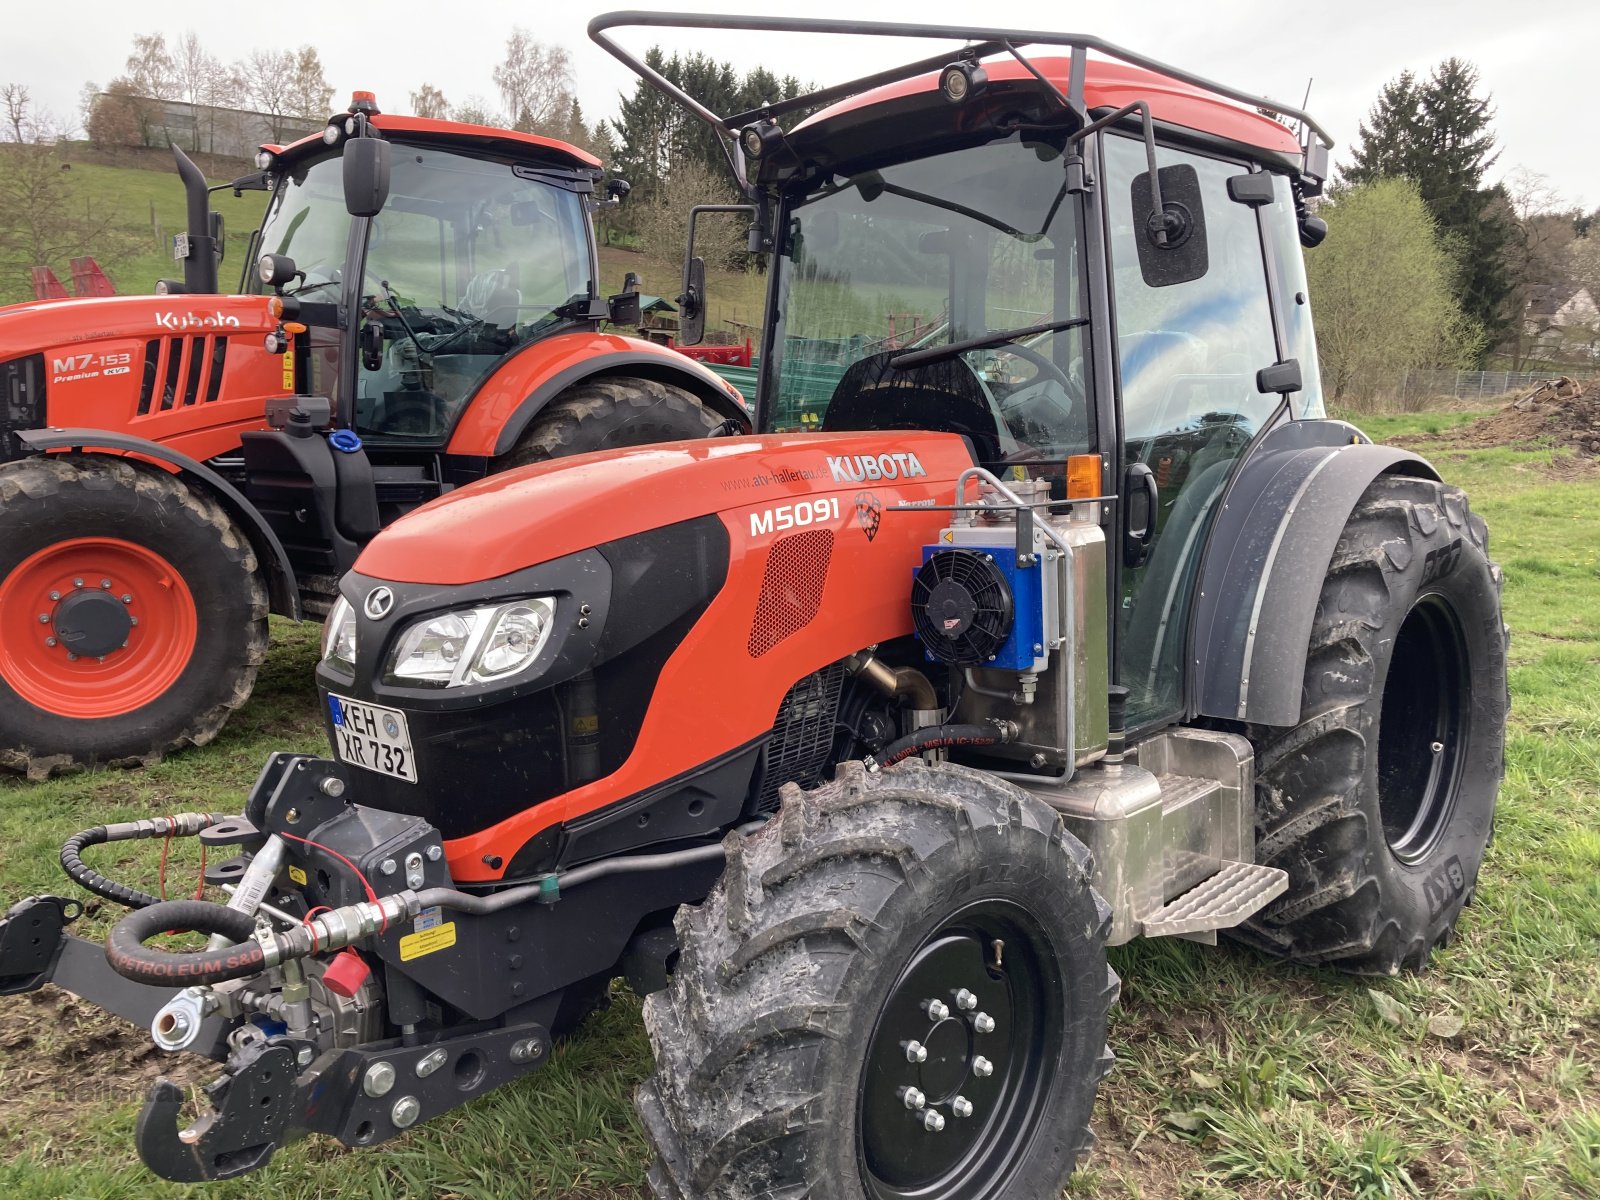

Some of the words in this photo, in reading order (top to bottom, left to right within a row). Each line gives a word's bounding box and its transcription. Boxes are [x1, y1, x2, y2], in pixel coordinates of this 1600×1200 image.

[155, 311, 240, 331] Kubota
[53, 353, 131, 375] M7-153
[53, 371, 100, 384] Premium
[107, 367, 127, 375] KVT
[720, 468, 828, 493] www.atv-hallertau.de
[825, 452, 927, 483] KUBOTA
[750, 498, 840, 537] M5091
[340, 702, 378, 738] KEH
[341, 731, 367, 765] XR
[369, 740, 407, 777] 732
[117, 955, 222, 977] PETROLEUM
[226, 949, 263, 969] S&D
